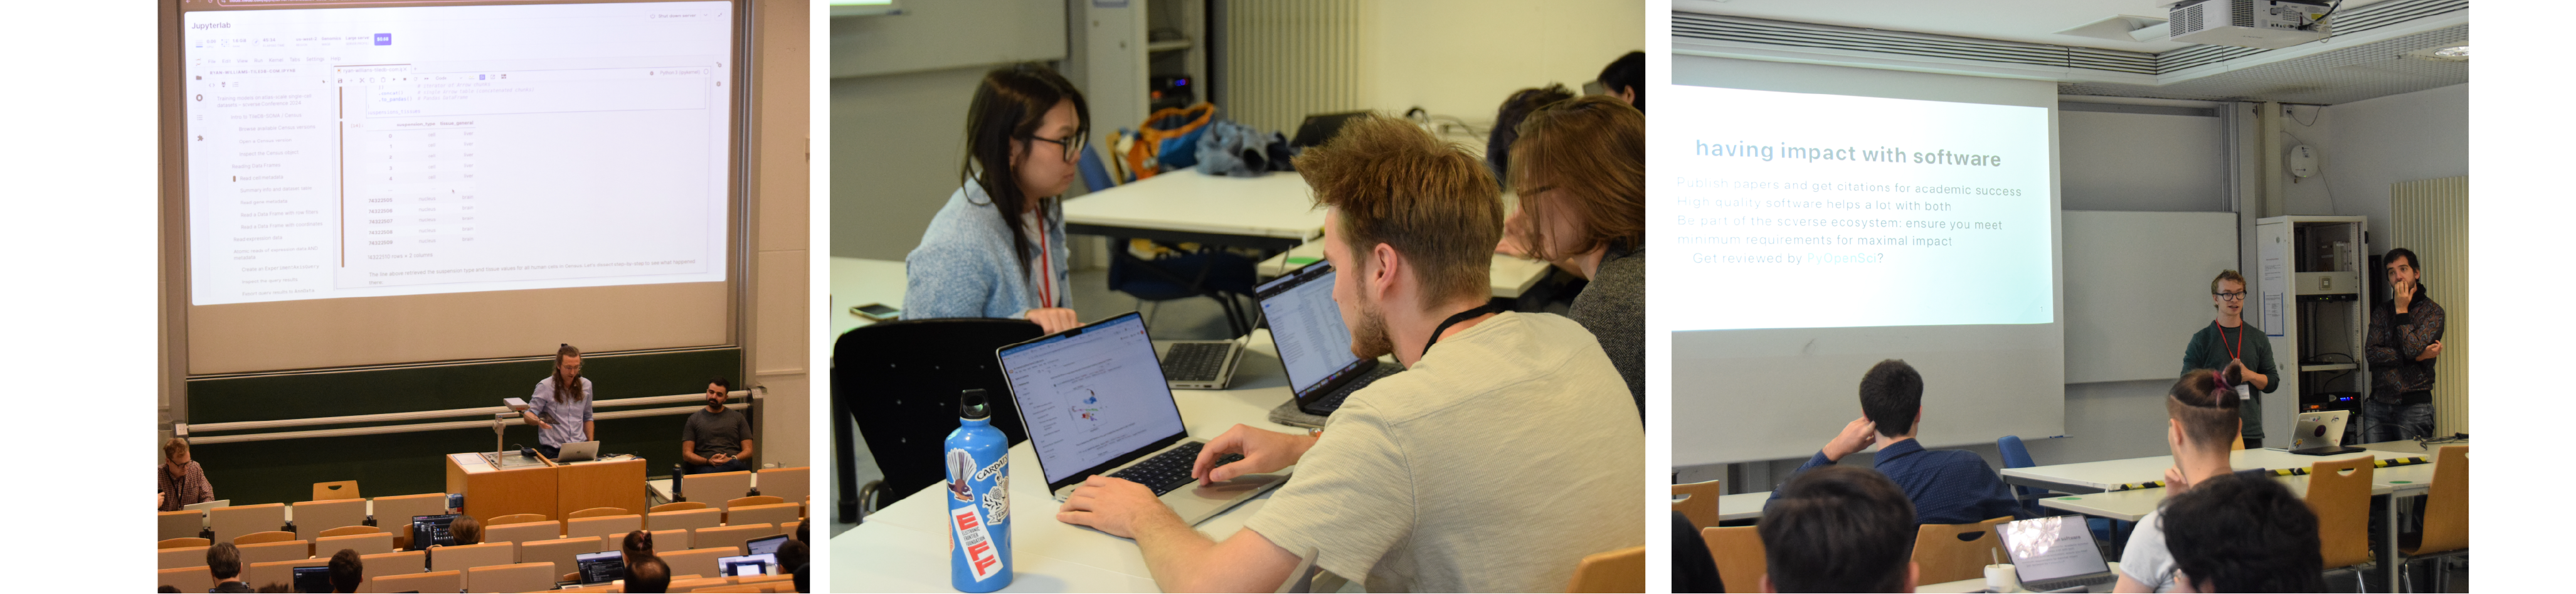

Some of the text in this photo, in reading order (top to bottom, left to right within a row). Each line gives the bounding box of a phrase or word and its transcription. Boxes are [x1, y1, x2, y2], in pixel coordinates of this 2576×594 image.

[192, 22, 231, 30] Jupyterlab
[1697, 139, 2001, 167] having impact with software
[1678, 177, 2022, 196] Publish papers and get citations for academic success
[1678, 196, 1709, 208] High
[1715, 198, 1761, 209] quality
[1766, 198, 1822, 208] software
[1827, 199, 1860, 211] helps
[1876, 200, 1891, 209] lot
[1895, 201, 1920, 210] with
[1925, 201, 1951, 211] both
[1678, 215, 2002, 231] Be part of the scverse ecosystem: ensure you meet
[1678, 234, 1952, 248] minimum requirements for maximal impact
[1693, 253, 1884, 265] Get reviewed by PyOpenSci?
[961, 526, 980, 536] ELECTRONIC
[963, 532, 979, 541] FRONTIER
[966, 535, 986, 547] FOUNDATION
